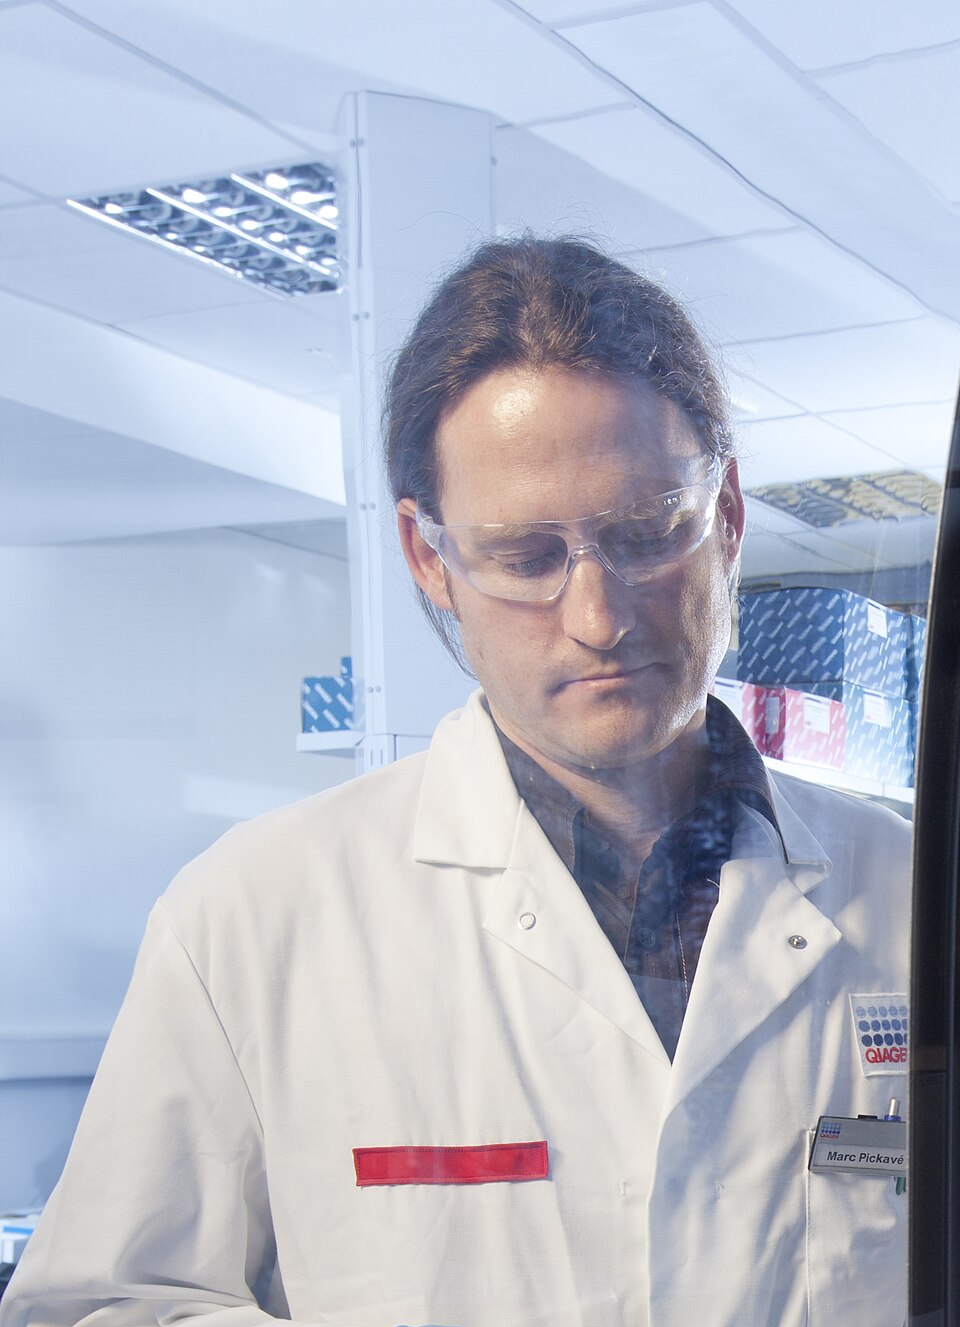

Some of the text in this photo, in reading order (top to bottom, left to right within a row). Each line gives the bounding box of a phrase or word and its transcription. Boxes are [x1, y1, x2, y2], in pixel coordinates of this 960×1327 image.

[865, 1046, 907, 1063] QIAGE
[827, 1151, 905, 1165] Marc Pickavé
